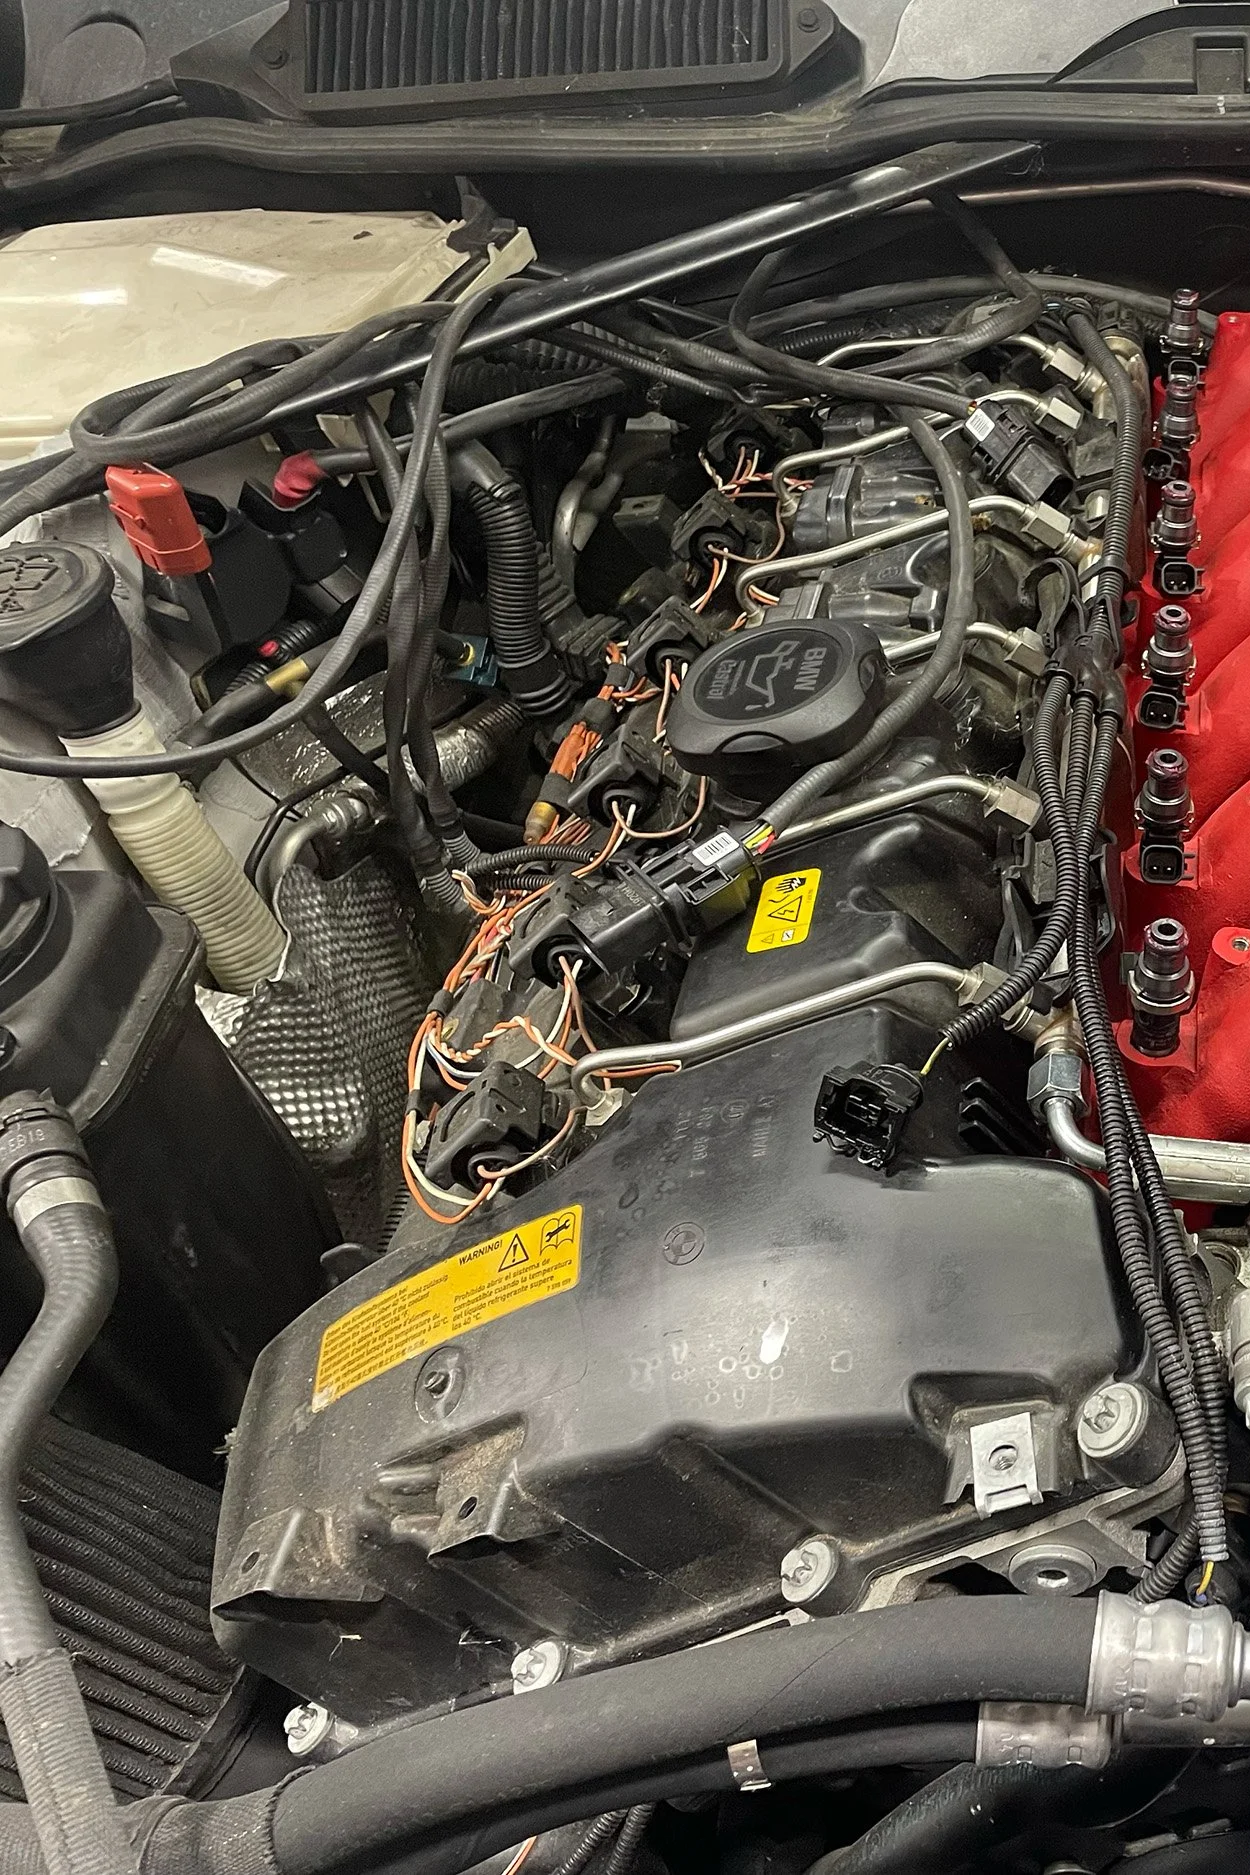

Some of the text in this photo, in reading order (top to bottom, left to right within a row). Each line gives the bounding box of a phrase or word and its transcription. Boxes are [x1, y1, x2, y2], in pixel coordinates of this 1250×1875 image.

[706, 659, 737, 700] Castrol
[793, 647, 827, 691] BMW
[458, 1239, 503, 1266] WARNING!
[512, 1262, 540, 1278] sistema
[542, 1258, 551, 1267] de
[529, 1258, 573, 1282] temperatura
[530, 1274, 555, 1291] supere
